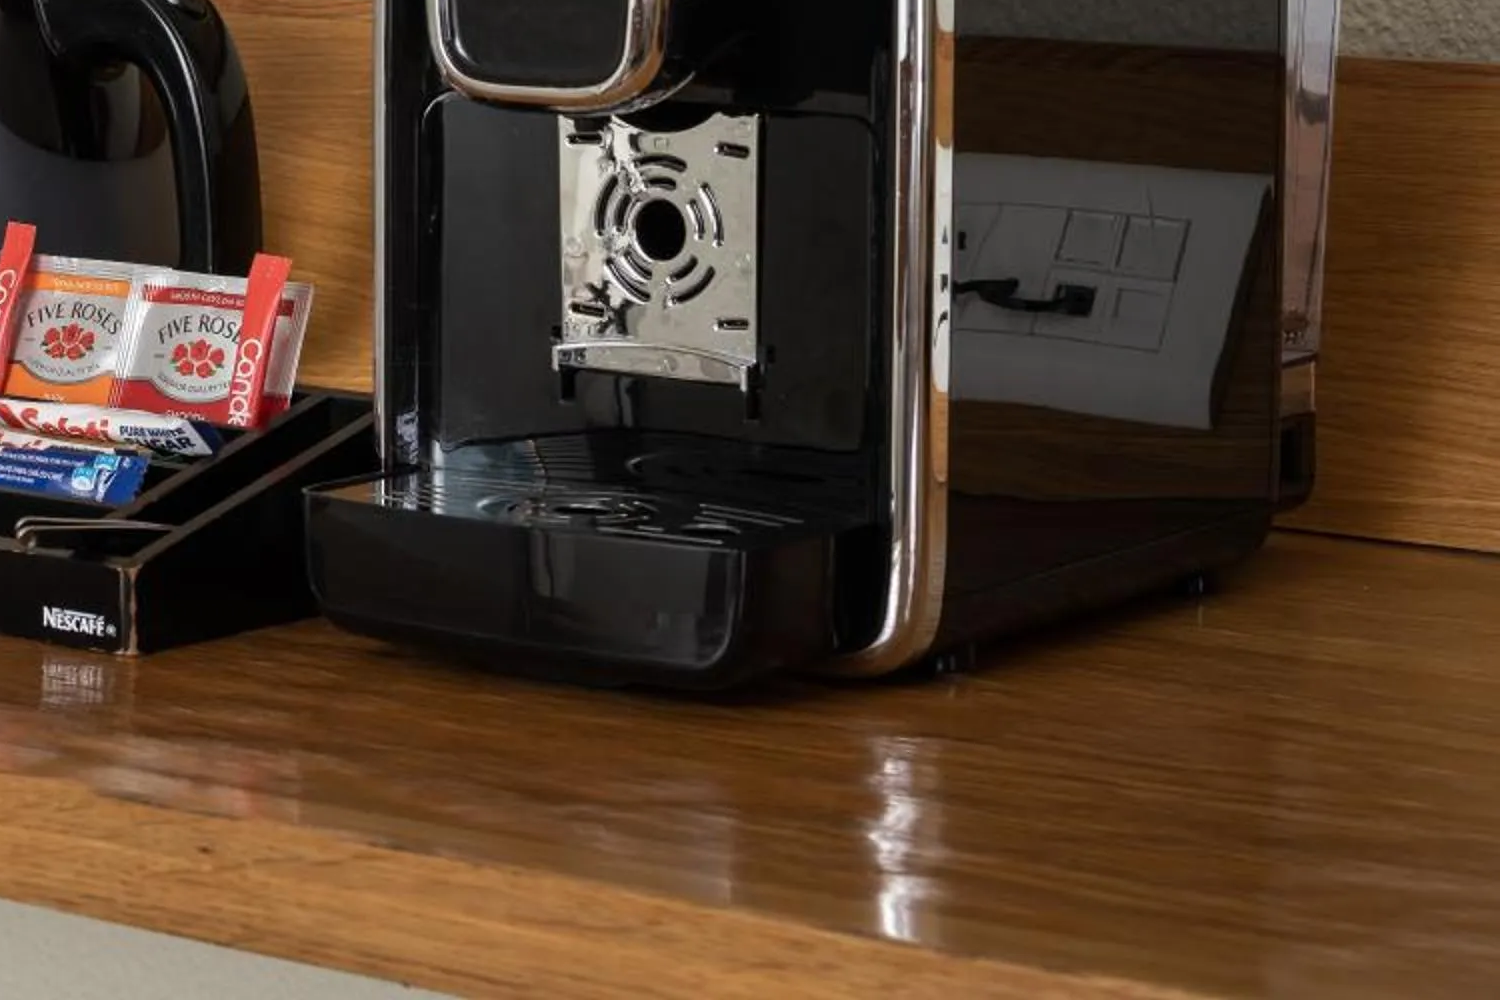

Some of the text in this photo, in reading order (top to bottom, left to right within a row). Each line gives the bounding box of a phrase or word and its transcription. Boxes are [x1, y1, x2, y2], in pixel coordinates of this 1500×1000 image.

[27, 301, 122, 335] FIVE ROSES
[158, 313, 241, 345] FIVE ROS
[119, 425, 186, 438] PURE WHITE
